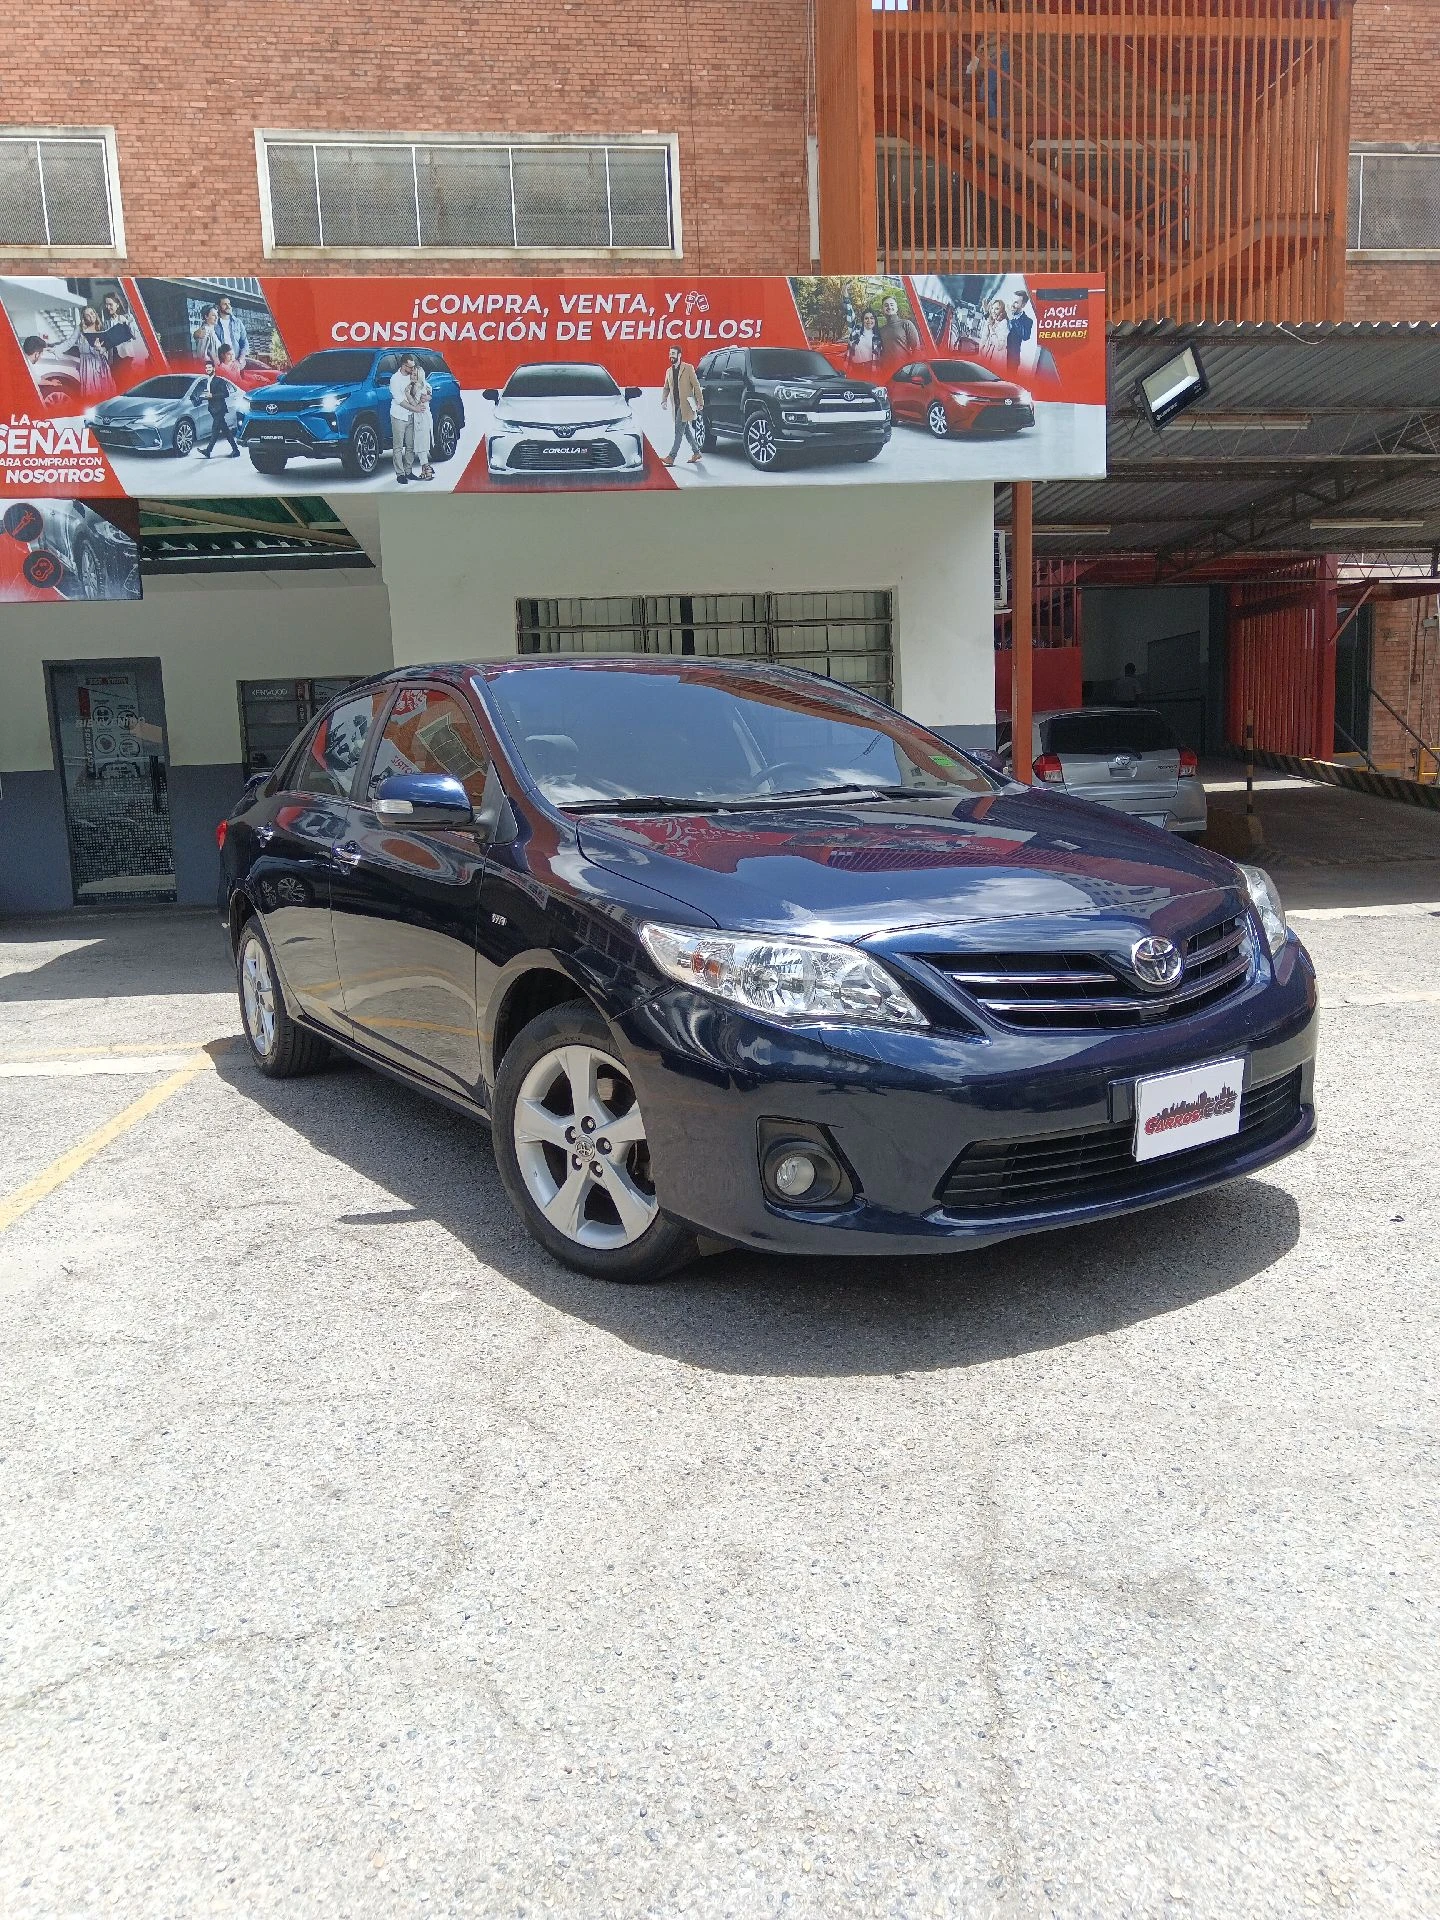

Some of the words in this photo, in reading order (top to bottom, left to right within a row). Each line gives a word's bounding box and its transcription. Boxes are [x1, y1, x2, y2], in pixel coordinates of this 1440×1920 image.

[412, 294, 549, 319] ¡COMPRA,
[559, 293, 655, 317] VENTA,
[664, 292, 683, 314] Y
[1043, 304, 1078, 319] ¡AQUÍ
[331, 317, 547, 342] CONSIGNACIÓN
[556, 320, 593, 341] DE
[601, 314, 763, 340] VEHÍCULOS!
[1038, 330, 1088, 339] REALIDAD!
[10, 413, 31, 426] LA
[0, 457, 21, 467] ARA
[22, 457, 77, 467] COMPRAR
[78, 457, 102, 466] CON
[5, 467, 106, 484] NOSOTROS
[251, 688, 288, 696] KENWOOD
